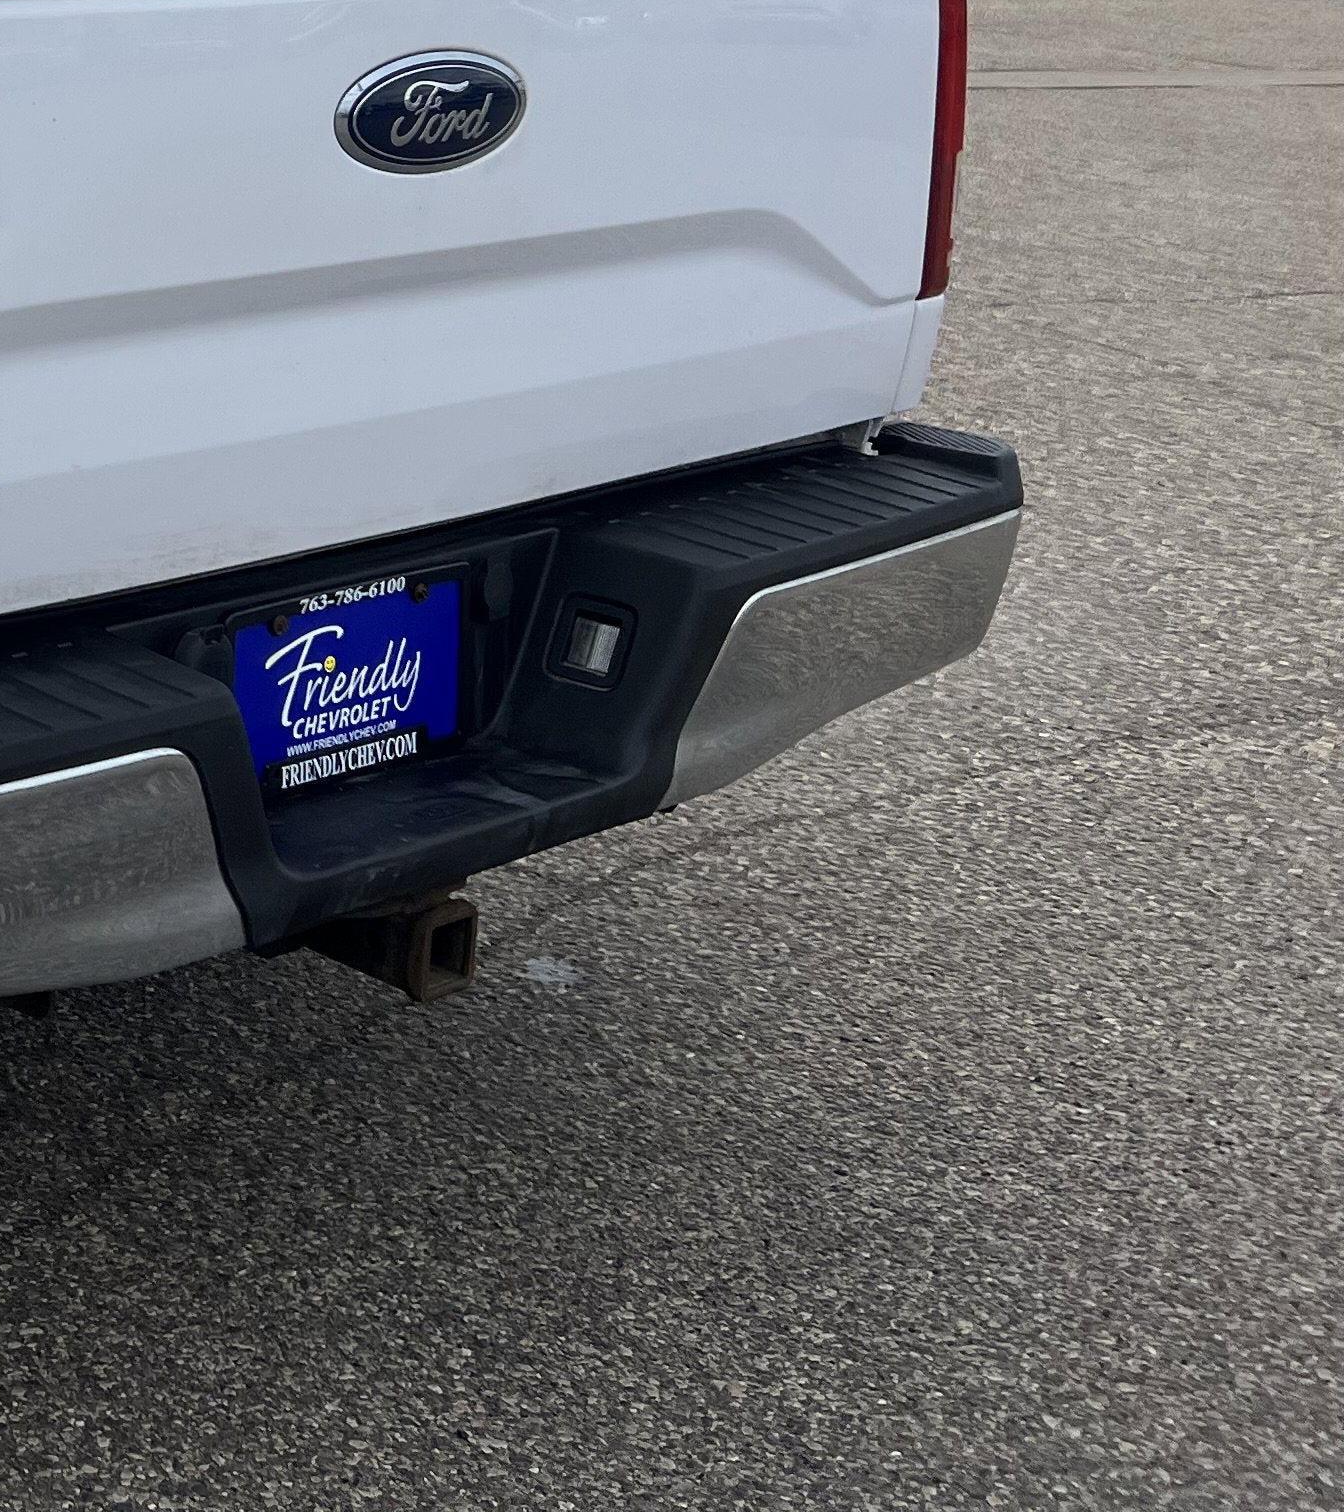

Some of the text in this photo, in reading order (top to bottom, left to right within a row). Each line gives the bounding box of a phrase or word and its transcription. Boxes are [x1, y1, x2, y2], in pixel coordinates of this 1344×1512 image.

[390, 80, 494, 147] Ford
[299, 576, 406, 614] 763-786-6100
[265, 625, 421, 727] Friendly
[286, 719, 397, 757] WWW.FRIENDLYCHEV.COM
[293, 696, 391, 739] CHEVROLET
[281, 731, 418, 789] FRIENDLYCHEV.COM
